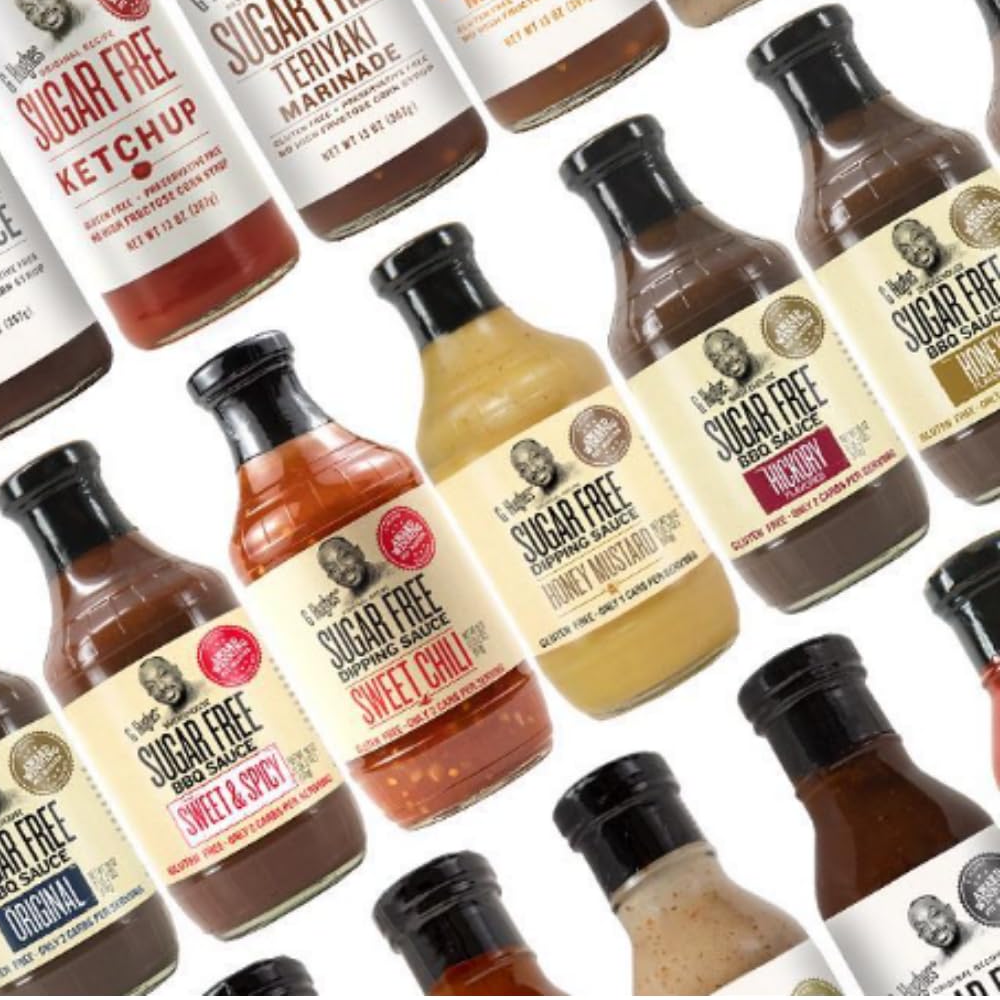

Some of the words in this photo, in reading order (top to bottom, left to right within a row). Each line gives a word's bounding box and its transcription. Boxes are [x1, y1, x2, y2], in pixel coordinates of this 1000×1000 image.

[17, 61, 116, 150] SUGAR
[99, 26, 176, 102] FREE
[272, 17, 376, 92] TERIYAKI
[280, 44, 399, 121] MARINADE
[57, 98, 195, 194] KETCHUP
[892, 284, 968, 351] SUGAR
[705, 393, 779, 460] SUGAR
[767, 365, 826, 424] FREE
[737, 442, 771, 469] BBQ
[771, 412, 822, 449] SAUCE
[761, 439, 826, 493] HICKORY
[511, 499, 584, 562] SUGAR
[573, 471, 631, 527] FREE
[530, 536, 590, 576] DIPPING
[590, 508, 638, 541] SAUCE
[542, 563, 592, 608] HONEY
[587, 528, 656, 583] MUSTARD
[318, 603, 394, 668] SUGAR
[382, 574, 441, 632] FREE
[338, 642, 399, 683] DIPPING
[400, 612, 449, 648] SAUCE
[351, 660, 425, 723] SWEET
[414, 632, 472, 688] CHILI
[138, 720, 214, 786] SUGAR
[201, 692, 261, 750] FREE
[170, 768, 206, 794] BBQ
[205, 738, 257, 775] SAUCE
[14, 801, 75, 861] FREE
[178, 786, 231, 835] SWEET
[225, 779, 247, 809] &
[239, 755, 285, 800] SPICY
[19, 848, 69, 885] SAUCE
[5, 877, 85, 940] ORIGINAL
